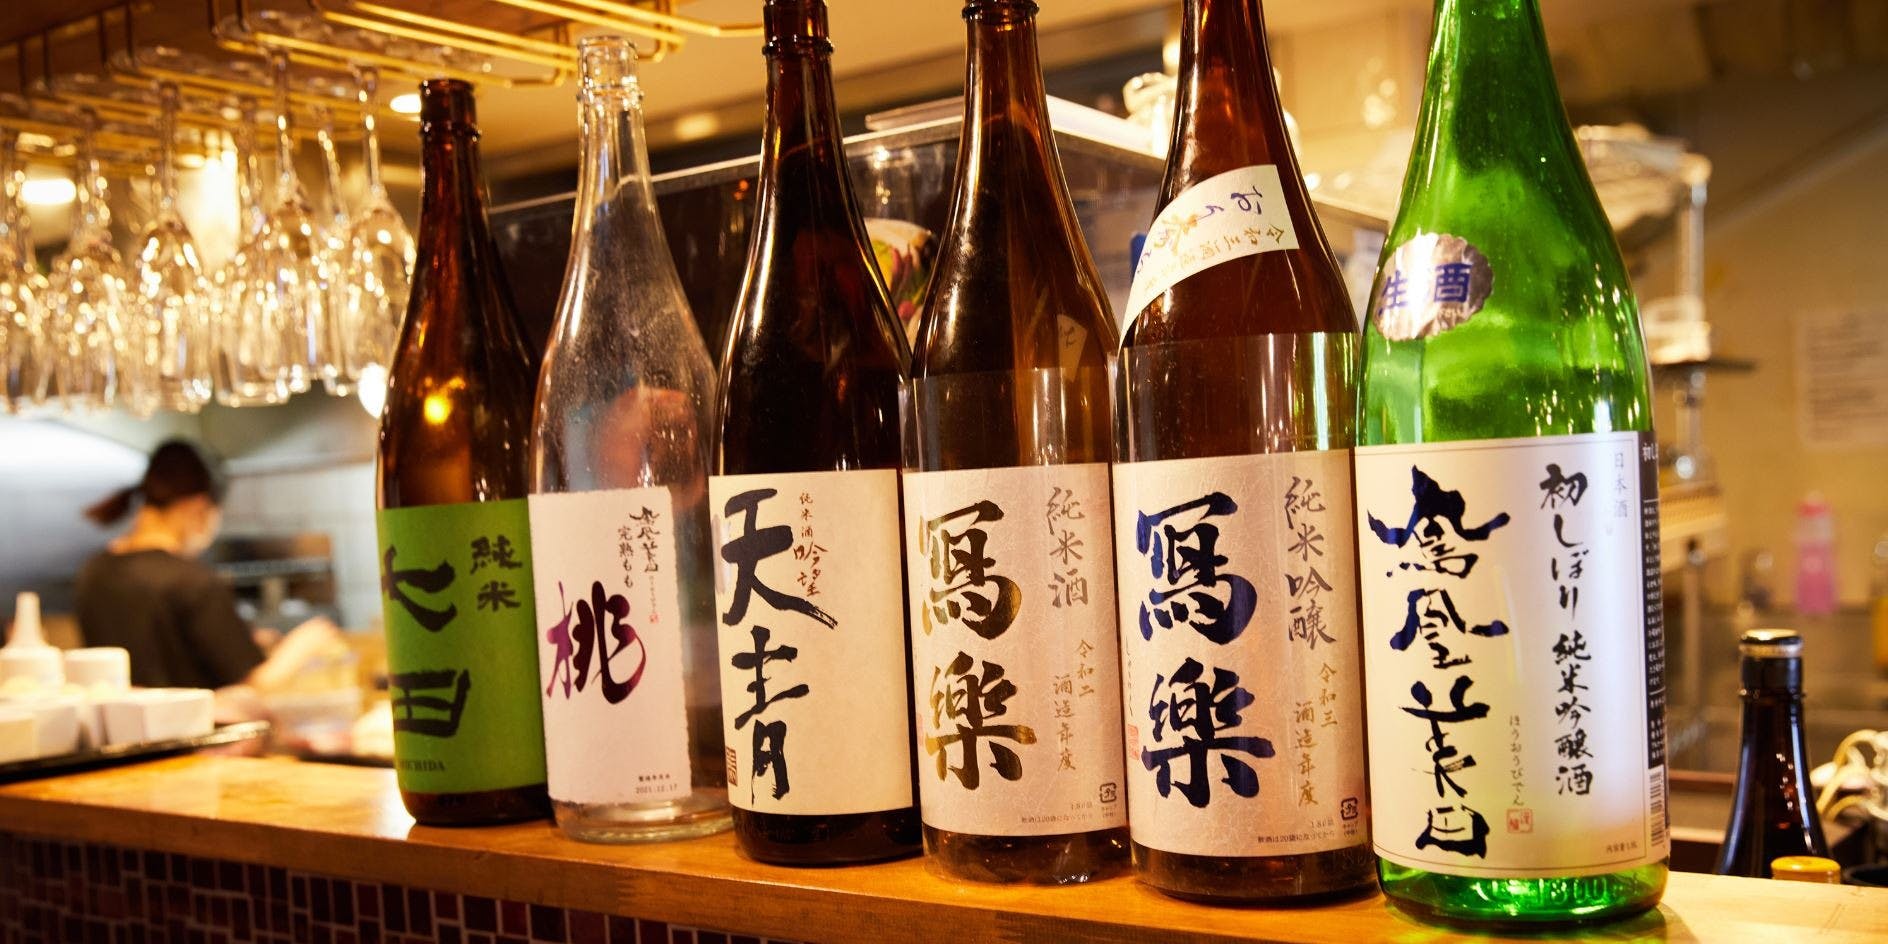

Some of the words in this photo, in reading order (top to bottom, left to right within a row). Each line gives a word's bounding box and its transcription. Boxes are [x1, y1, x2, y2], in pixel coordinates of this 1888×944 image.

[799, 492, 814, 539] 純米酒
[1047, 486, 1090, 609] 純米酒
[1539, 463, 1589, 622] 初しぼり
[469, 534, 524, 613] 純米
[380, 544, 472, 740] 七田
[546, 580, 647, 705] 桃
[720, 487, 838, 807] 天青
[1076, 640, 1095, 697] 令和二
[1052, 675, 1077, 773] 酒造年度
[1318, 662, 1338, 728] 令和三
[1294, 701, 1320, 809] 酒造年度
[1510, 714, 1525, 806] ほうおうびでん
